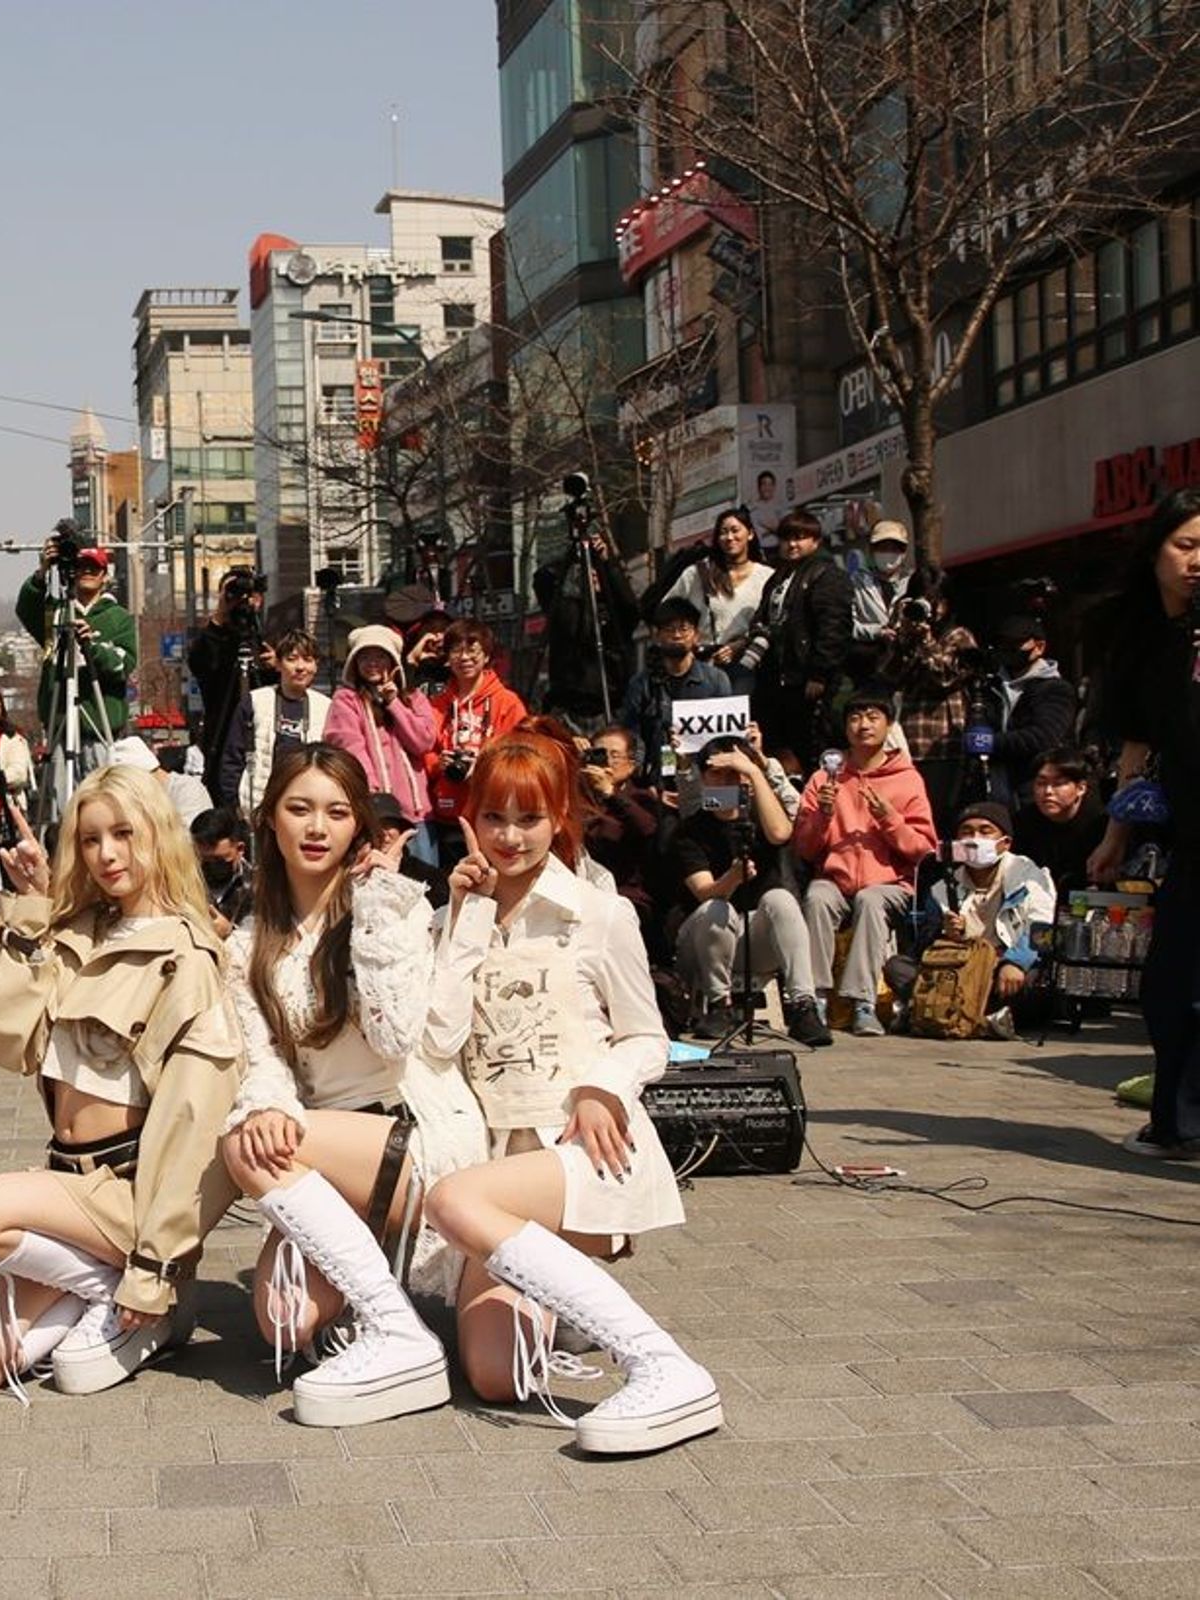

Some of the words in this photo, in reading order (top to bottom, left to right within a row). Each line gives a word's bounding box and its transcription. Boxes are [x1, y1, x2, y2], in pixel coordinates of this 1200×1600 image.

[840, 367, 874, 416] OPEN
[678, 713, 746, 735] XXIN
[745, 1117, 786, 1129] Roland
